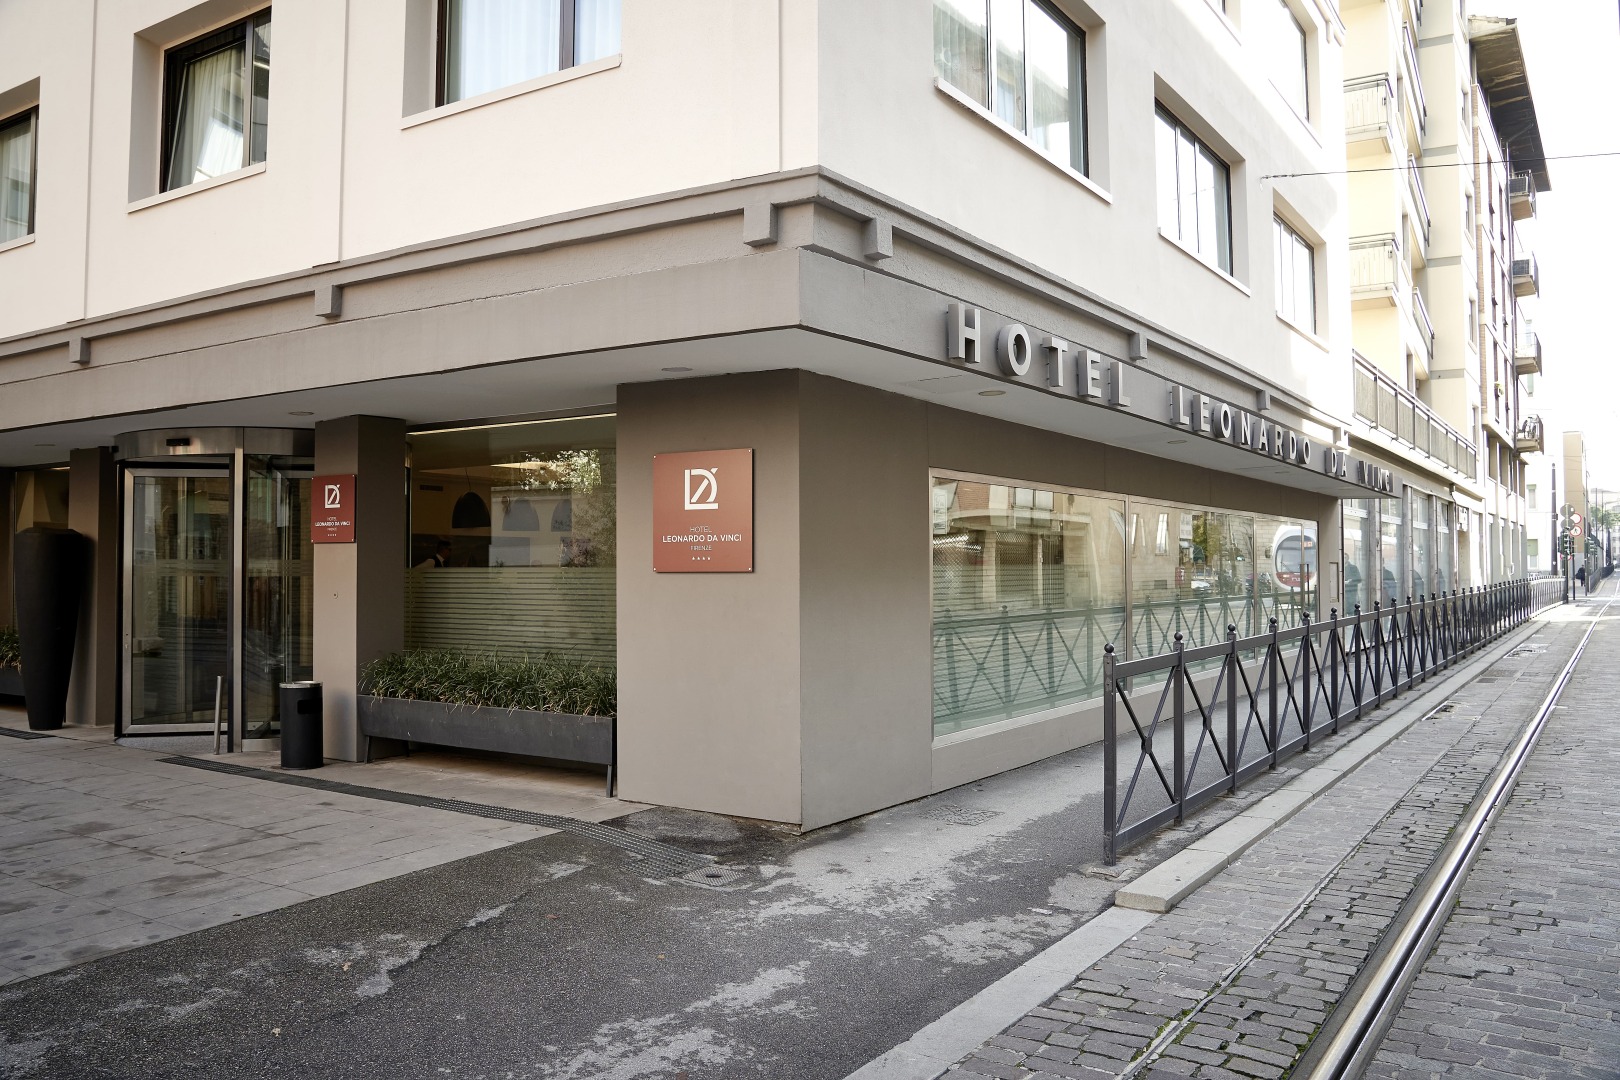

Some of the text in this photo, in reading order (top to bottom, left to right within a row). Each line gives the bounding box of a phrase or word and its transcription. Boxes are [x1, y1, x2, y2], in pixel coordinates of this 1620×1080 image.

[948, 303, 1131, 407] HOTEL
[1171, 385, 1311, 465] LEONARDO
[1325, 447, 1347, 478] DA
[690, 525, 712, 533] HOTEL
[662, 533, 742, 543] LEONARDO DA VINCI
